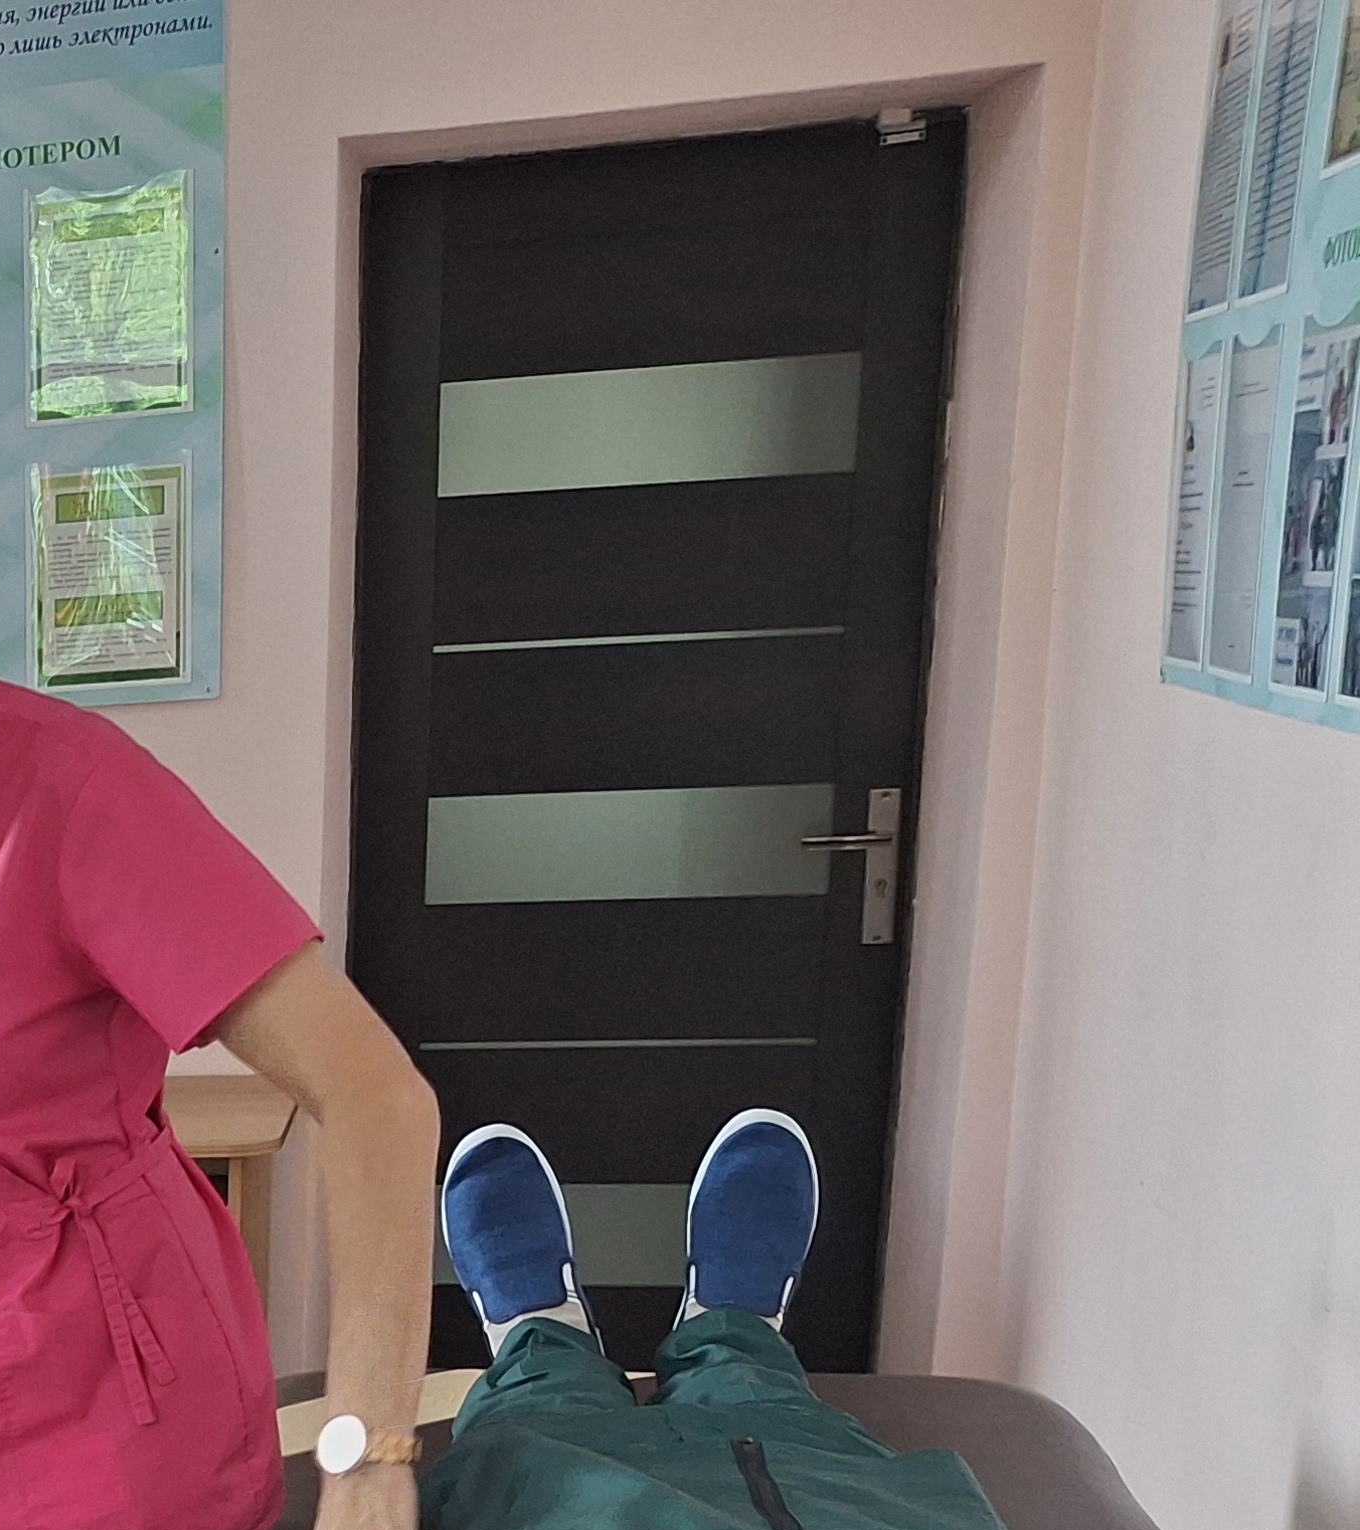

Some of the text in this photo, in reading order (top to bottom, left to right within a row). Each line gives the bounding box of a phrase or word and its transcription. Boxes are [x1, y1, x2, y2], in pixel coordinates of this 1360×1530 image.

[26, 0, 107, 26] энергии
[8, 31, 63, 56] лишь
[68, 13, 214, 47] электронами.
